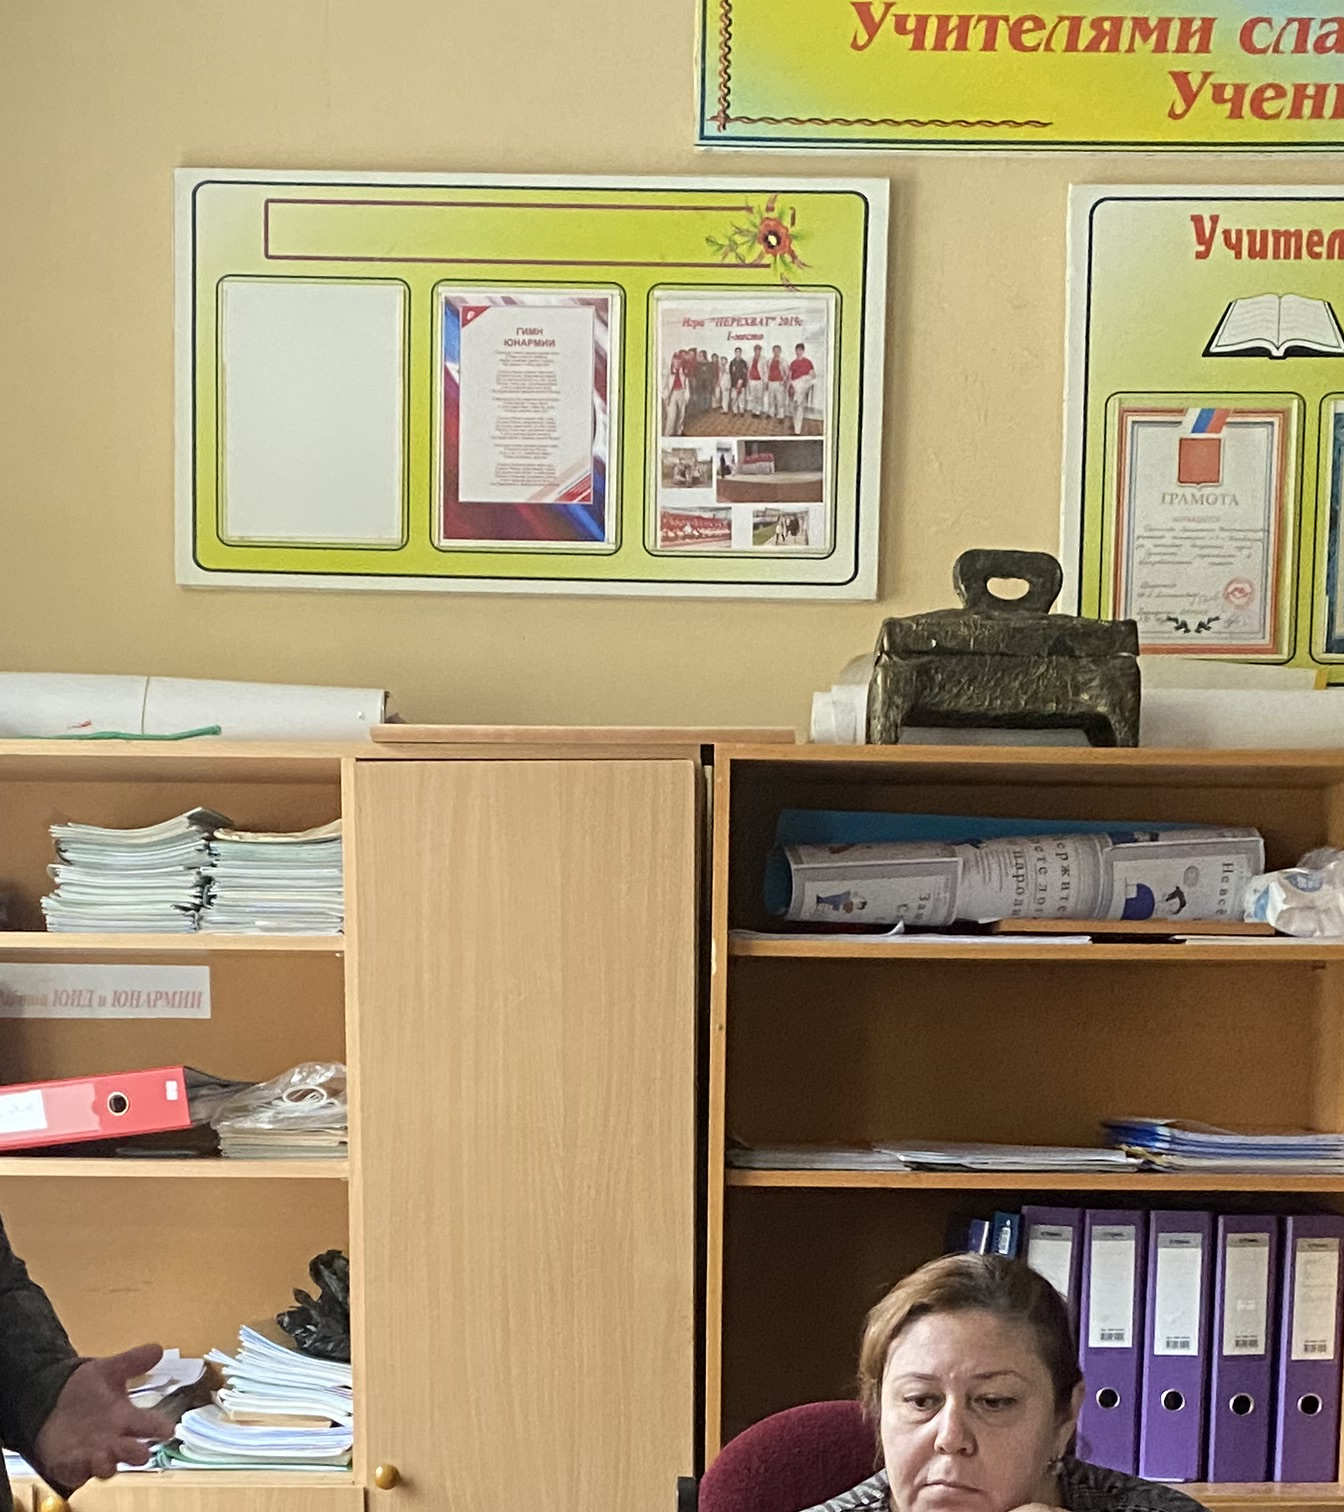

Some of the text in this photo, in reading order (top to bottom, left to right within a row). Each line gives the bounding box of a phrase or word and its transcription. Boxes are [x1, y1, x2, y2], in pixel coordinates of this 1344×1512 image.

[849, 1, 1219, 54] Учителями
[515, 327, 544, 336] ГИМН
[503, 338, 556, 348] ЮНАРМИИ
[1160, 491, 1240, 507] ГРАМОТА
